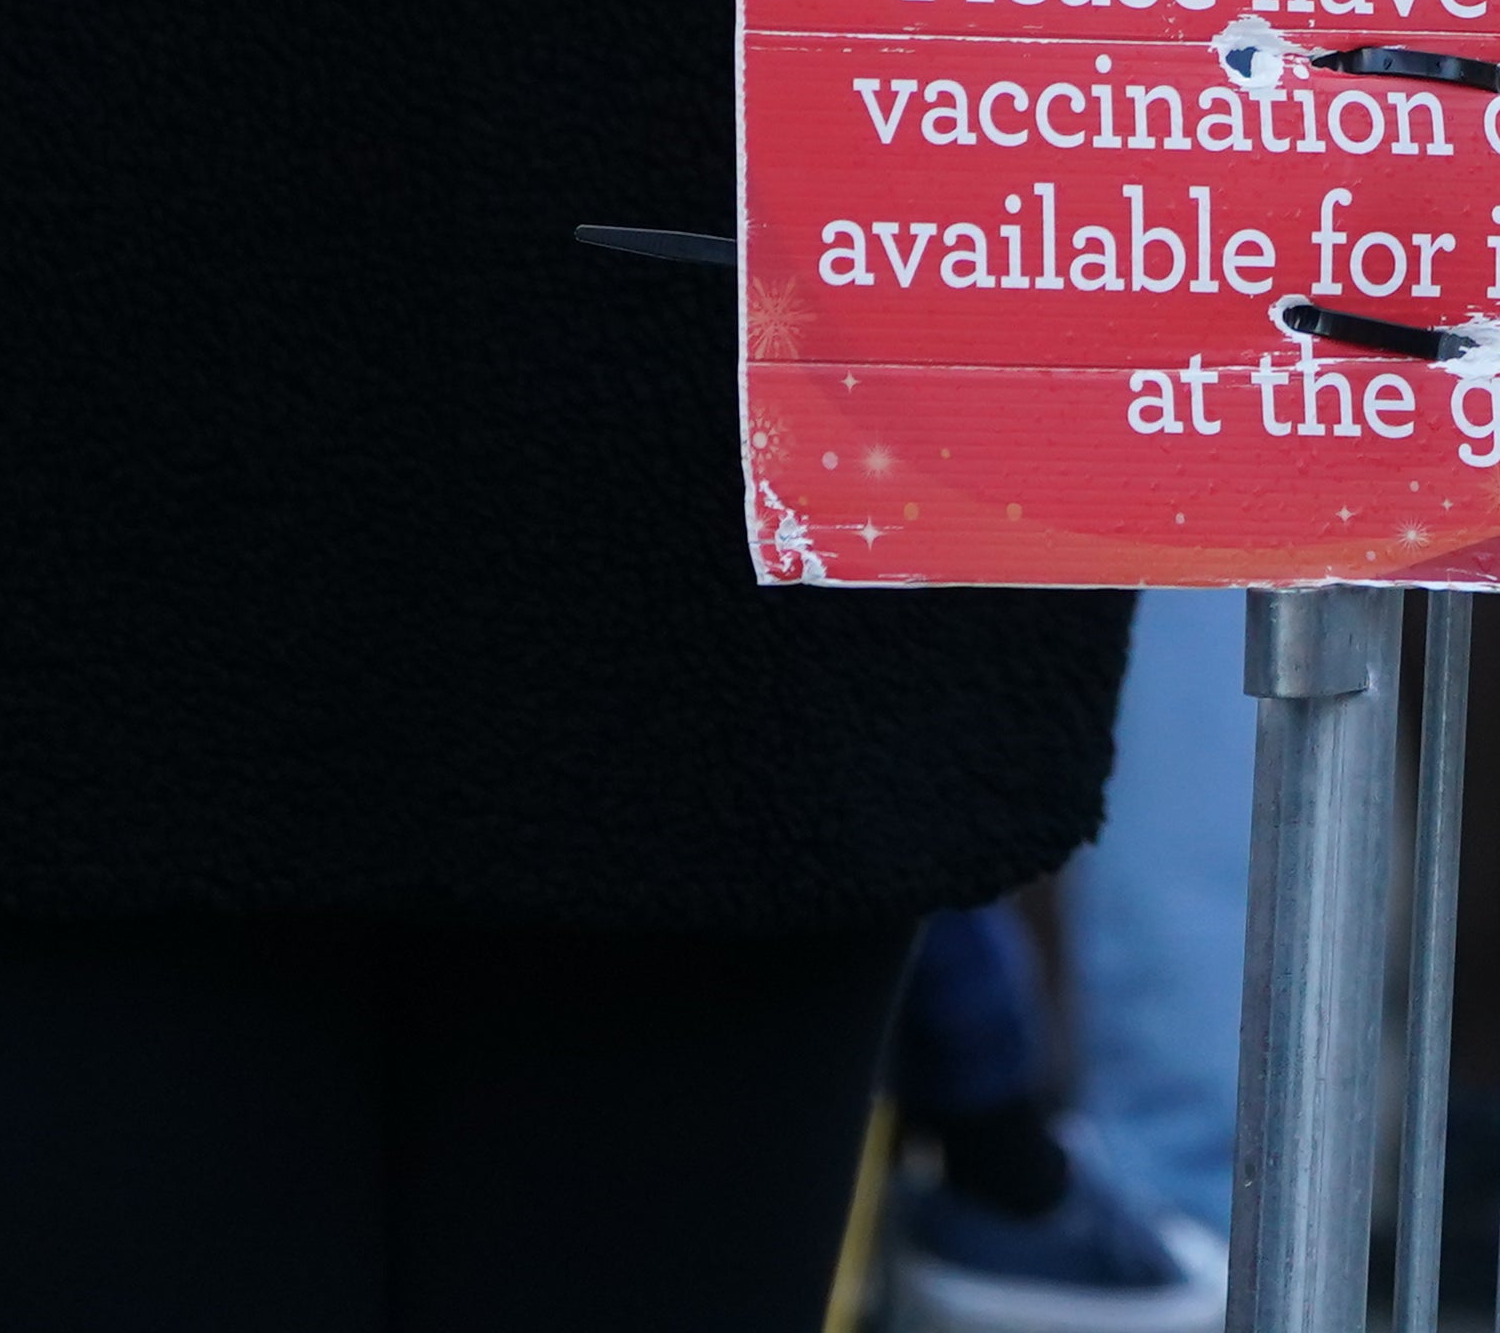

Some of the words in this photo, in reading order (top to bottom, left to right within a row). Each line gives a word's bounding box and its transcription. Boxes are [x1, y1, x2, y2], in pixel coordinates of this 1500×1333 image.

[853, 55, 1454, 156] vaccination
[818, 185, 1276, 297] available
[1310, 189, 1457, 299] for
[1127, 353, 1223, 436] at
[1251, 334, 1416, 439] the
